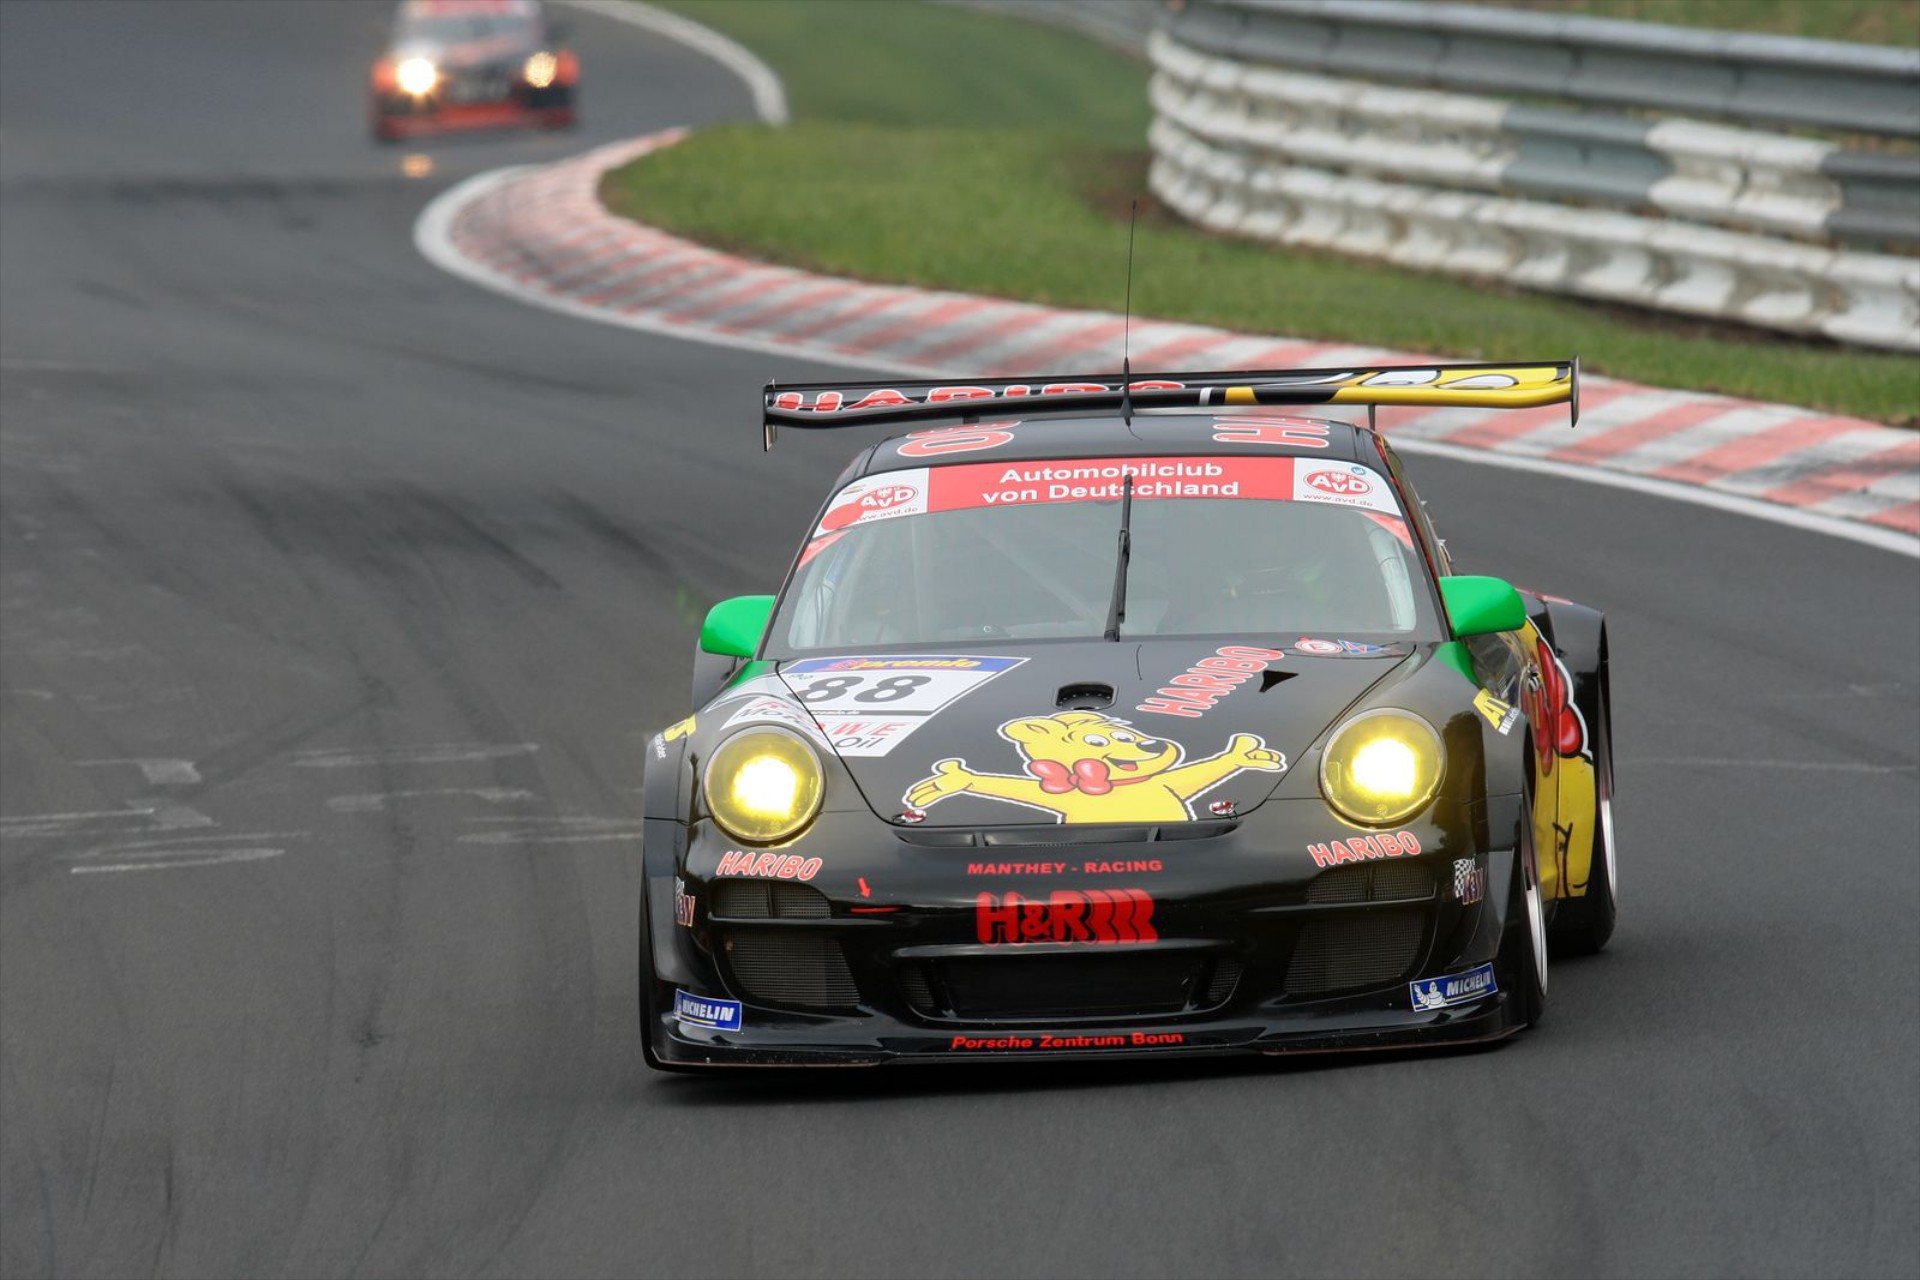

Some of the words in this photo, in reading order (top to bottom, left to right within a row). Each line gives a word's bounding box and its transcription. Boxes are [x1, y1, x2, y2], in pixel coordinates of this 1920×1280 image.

[1000, 463, 1223, 484] Automobilclub
[982, 488, 1038, 503] von
[1049, 481, 1240, 499] Deutschland
[787, 675, 932, 703] 88
[1135, 646, 1285, 718] HARIBO
[834, 737, 884, 749] Oil
[1307, 831, 1421, 868] HARIBO
[716, 851, 823, 881] HARIBO
[967, 863, 1067, 875] MANTHEY
[1084, 859, 1164, 874] RACING
[1446, 971, 1492, 997] MICHELIN
[951, 1035, 1034, 1049] Porsche
[1039, 1034, 1126, 1048] Zentrum
[1131, 1031, 1184, 1045] Bonn
